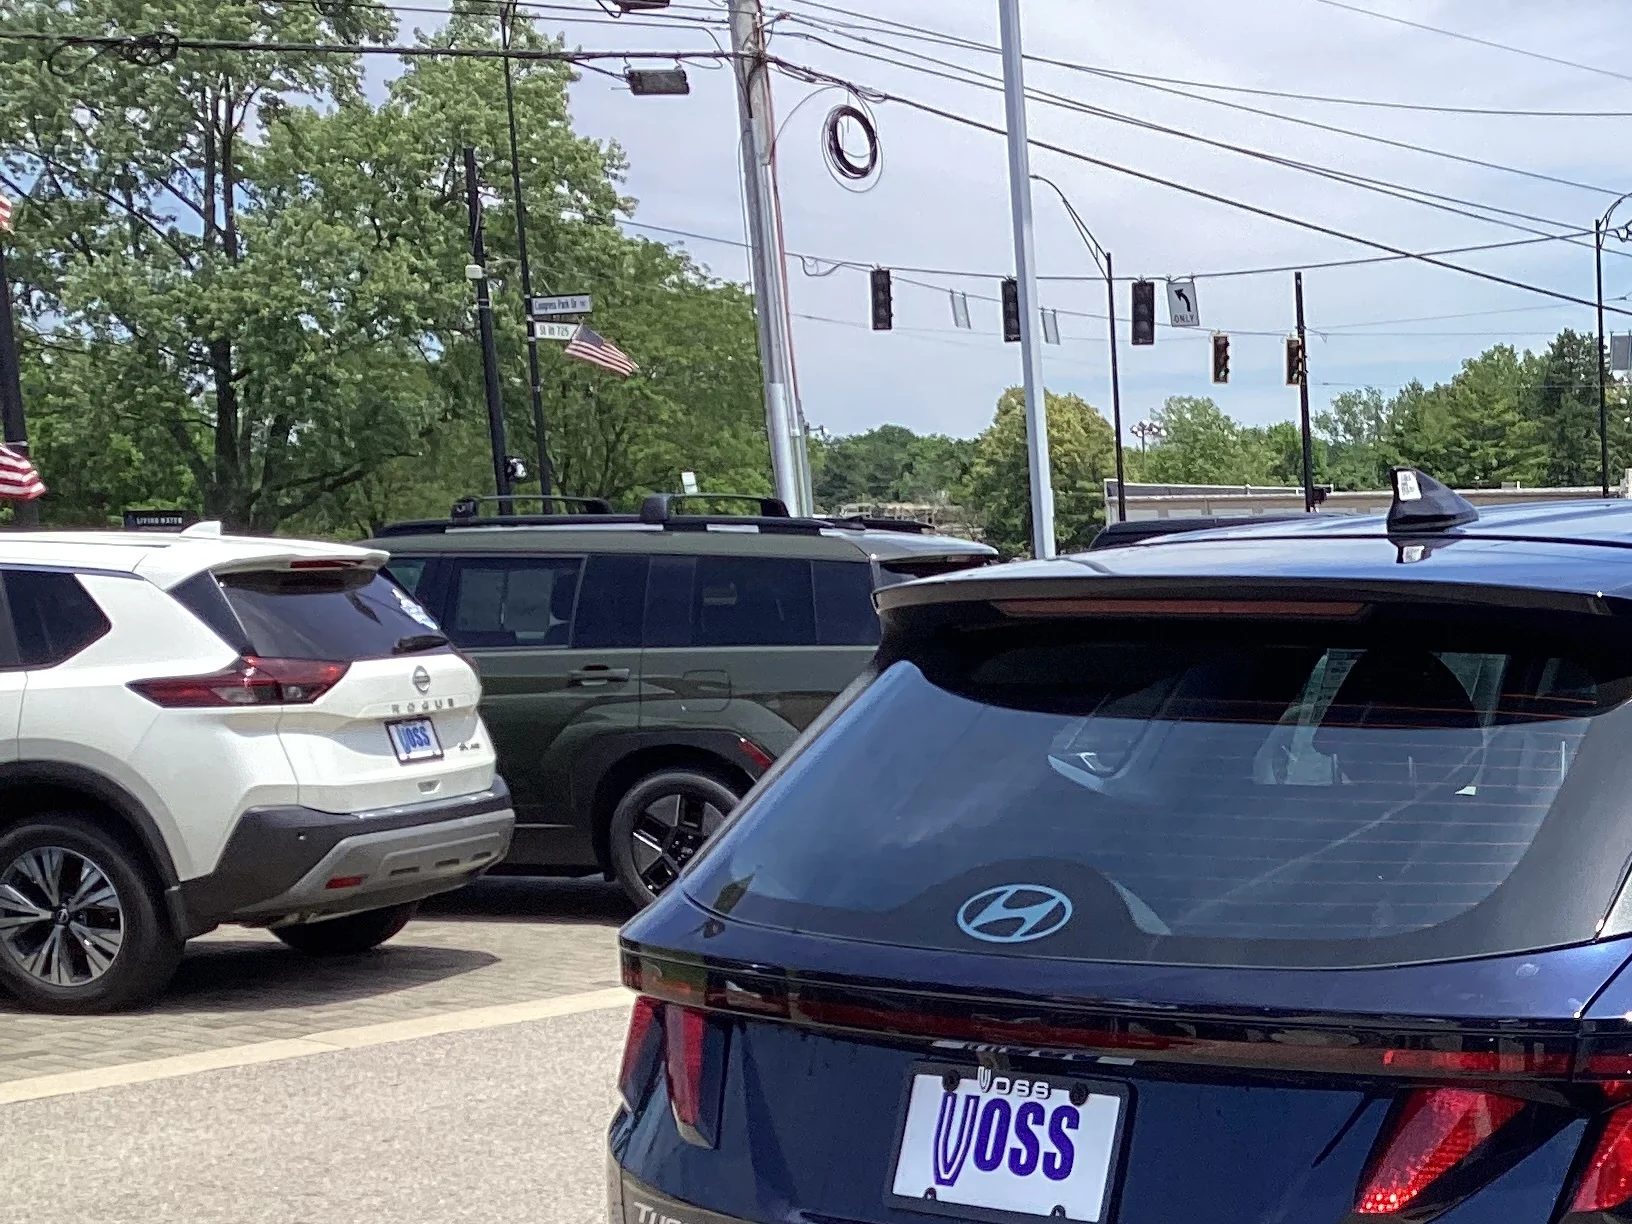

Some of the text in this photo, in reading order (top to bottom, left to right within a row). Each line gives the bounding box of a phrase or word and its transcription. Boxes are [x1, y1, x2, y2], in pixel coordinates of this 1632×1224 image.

[1174, 314, 1195, 324] ONLY
[391, 698, 454, 714] ROGUE
[395, 725, 431, 755] VOSS
[977, 1065, 1050, 1100] VOSS
[933, 1091, 1080, 1187] VOSS
